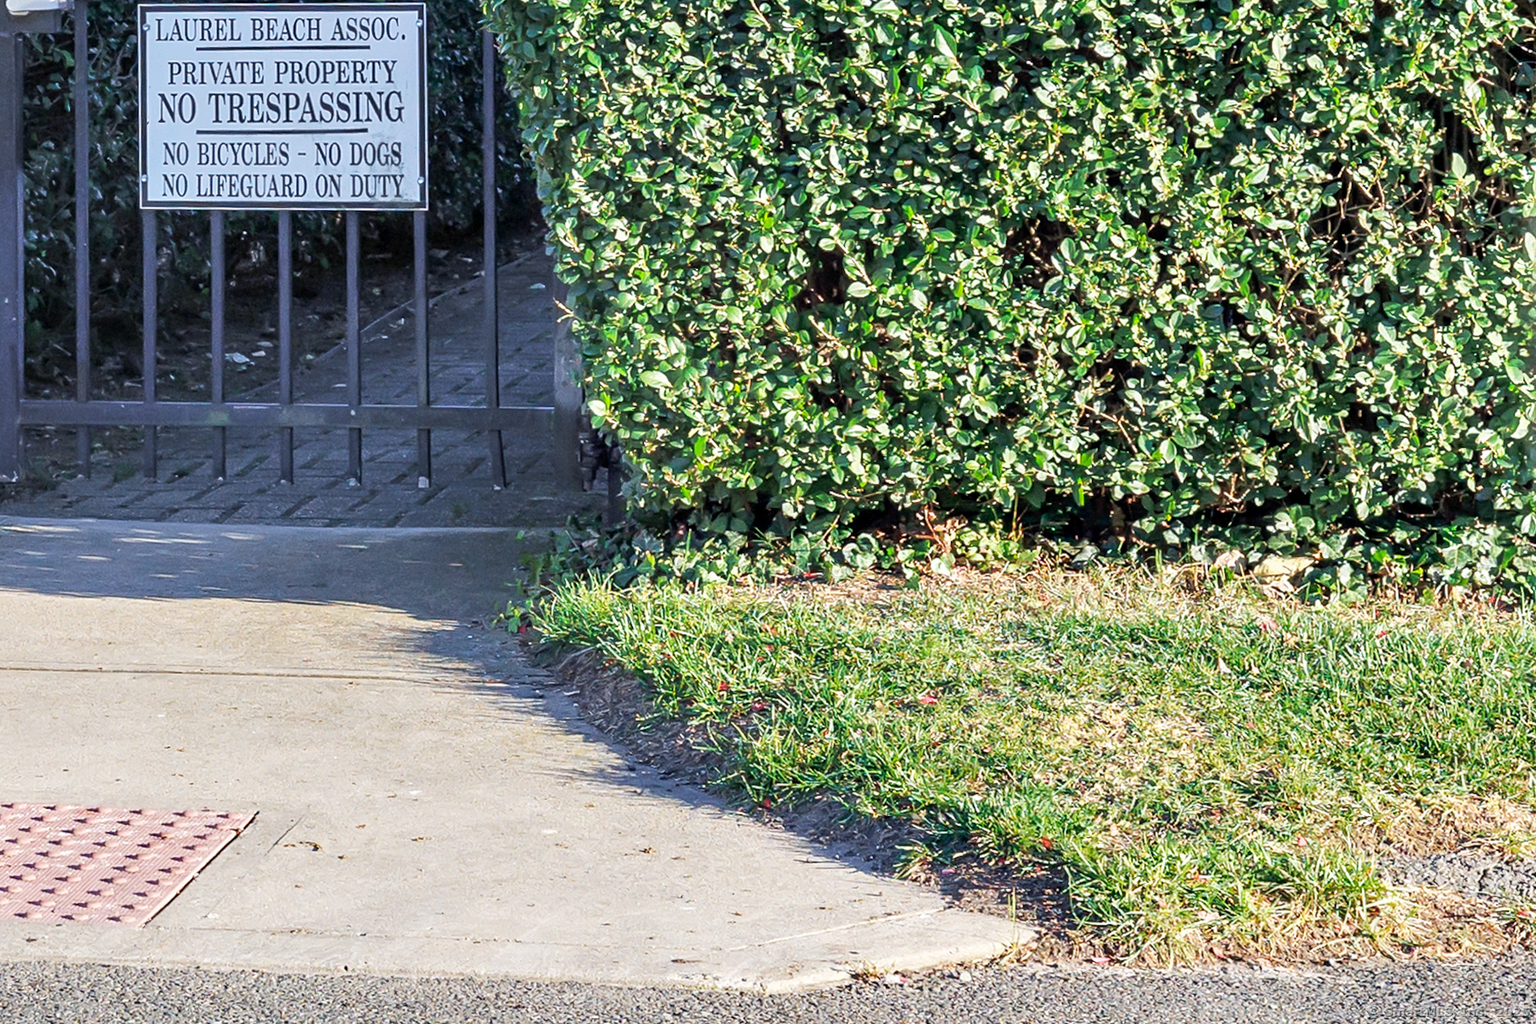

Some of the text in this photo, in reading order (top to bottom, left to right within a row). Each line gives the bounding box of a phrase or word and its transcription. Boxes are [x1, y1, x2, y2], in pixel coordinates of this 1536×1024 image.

[155, 16, 406, 42] LAUREL BEACH ASSOC.
[167, 60, 397, 85] PRIVATE PROPERTY
[158, 91, 405, 124] NO TRESPASSING
[162, 141, 189, 166] NO
[197, 141, 290, 167] BICYCLES
[314, 142, 342, 167] NO
[349, 141, 402, 167] DOGS
[162, 173, 405, 198] NO LIFEGUARD ON DUTY
